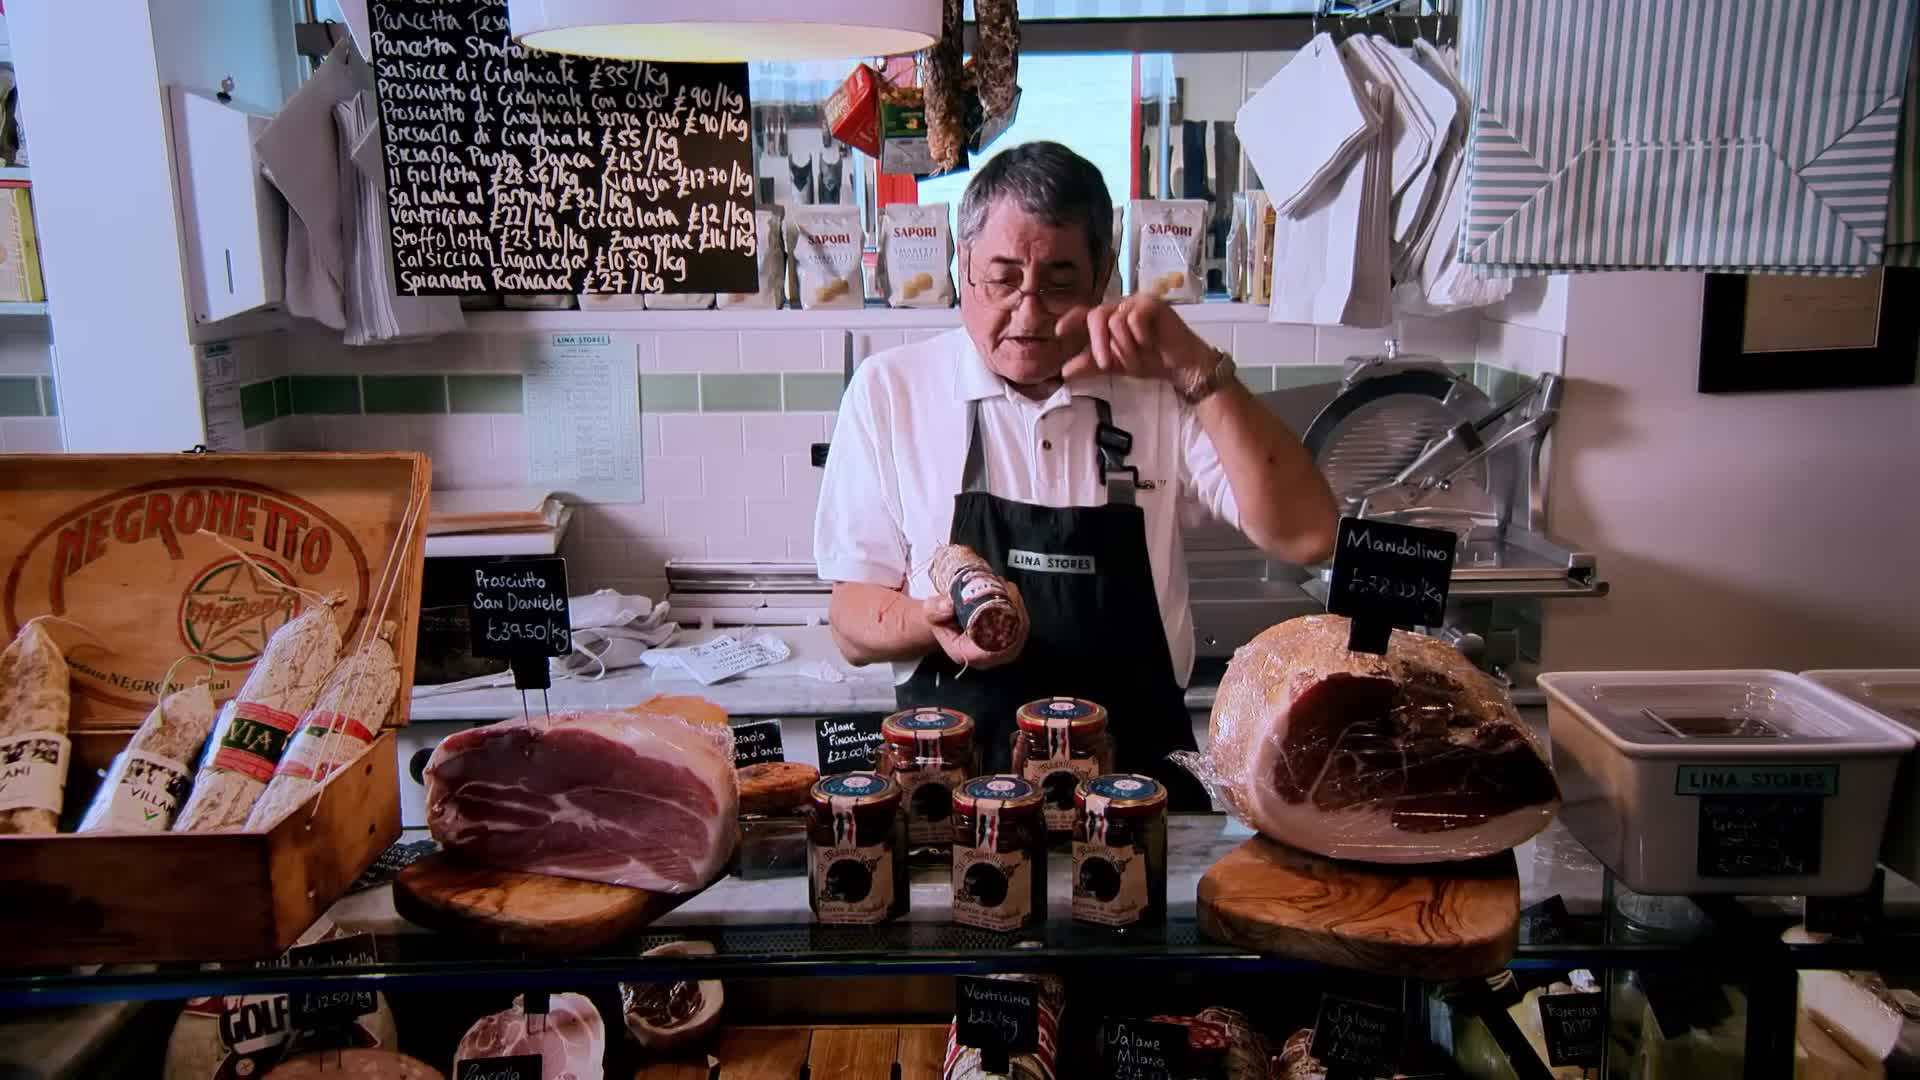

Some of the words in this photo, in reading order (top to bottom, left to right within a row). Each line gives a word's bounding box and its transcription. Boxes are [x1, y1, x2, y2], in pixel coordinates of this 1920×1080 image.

[372, 3, 462, 33] Pancetta
[467, 6, 511, 33] Tesa
[371, 31, 456, 57] Pancetta
[456, 61, 477, 83] di
[589, 61, 669, 97] £35/kg
[378, 79, 466, 102] Prosciutto
[470, 84, 488, 103] di
[591, 93, 617, 109] con
[381, 100, 466, 124] Prosciutto
[475, 105, 496, 123] di
[386, 124, 463, 144] Bresaola
[474, 124, 491, 145] di
[385, 144, 462, 166] Bresaola
[388, 183, 461, 206] Salame
[466, 185, 485, 205] al
[807, 233, 851, 246] SAPORI
[893, 226, 938, 239] SAPORI
[1148, 223, 1193, 237] SAPORI
[397, 249, 485, 268] Salsiccia
[400, 270, 487, 296] Spianata
[48, 490, 334, 618] NEGRONETTO
[1346, 529, 1448, 561] Mandolino
[1014, 555, 1041, 566] LINA
[1047, 558, 1090, 569] STORES
[475, 569, 545, 589] Prosciutto
[474, 592, 503, 609] San
[507, 592, 565, 612] Daniele
[486, 616, 569, 652] £39.50/kg
[820, 721, 857, 737] Salame
[1689, 773, 1738, 788] LINA
[1751, 773, 1827, 789] STORES
